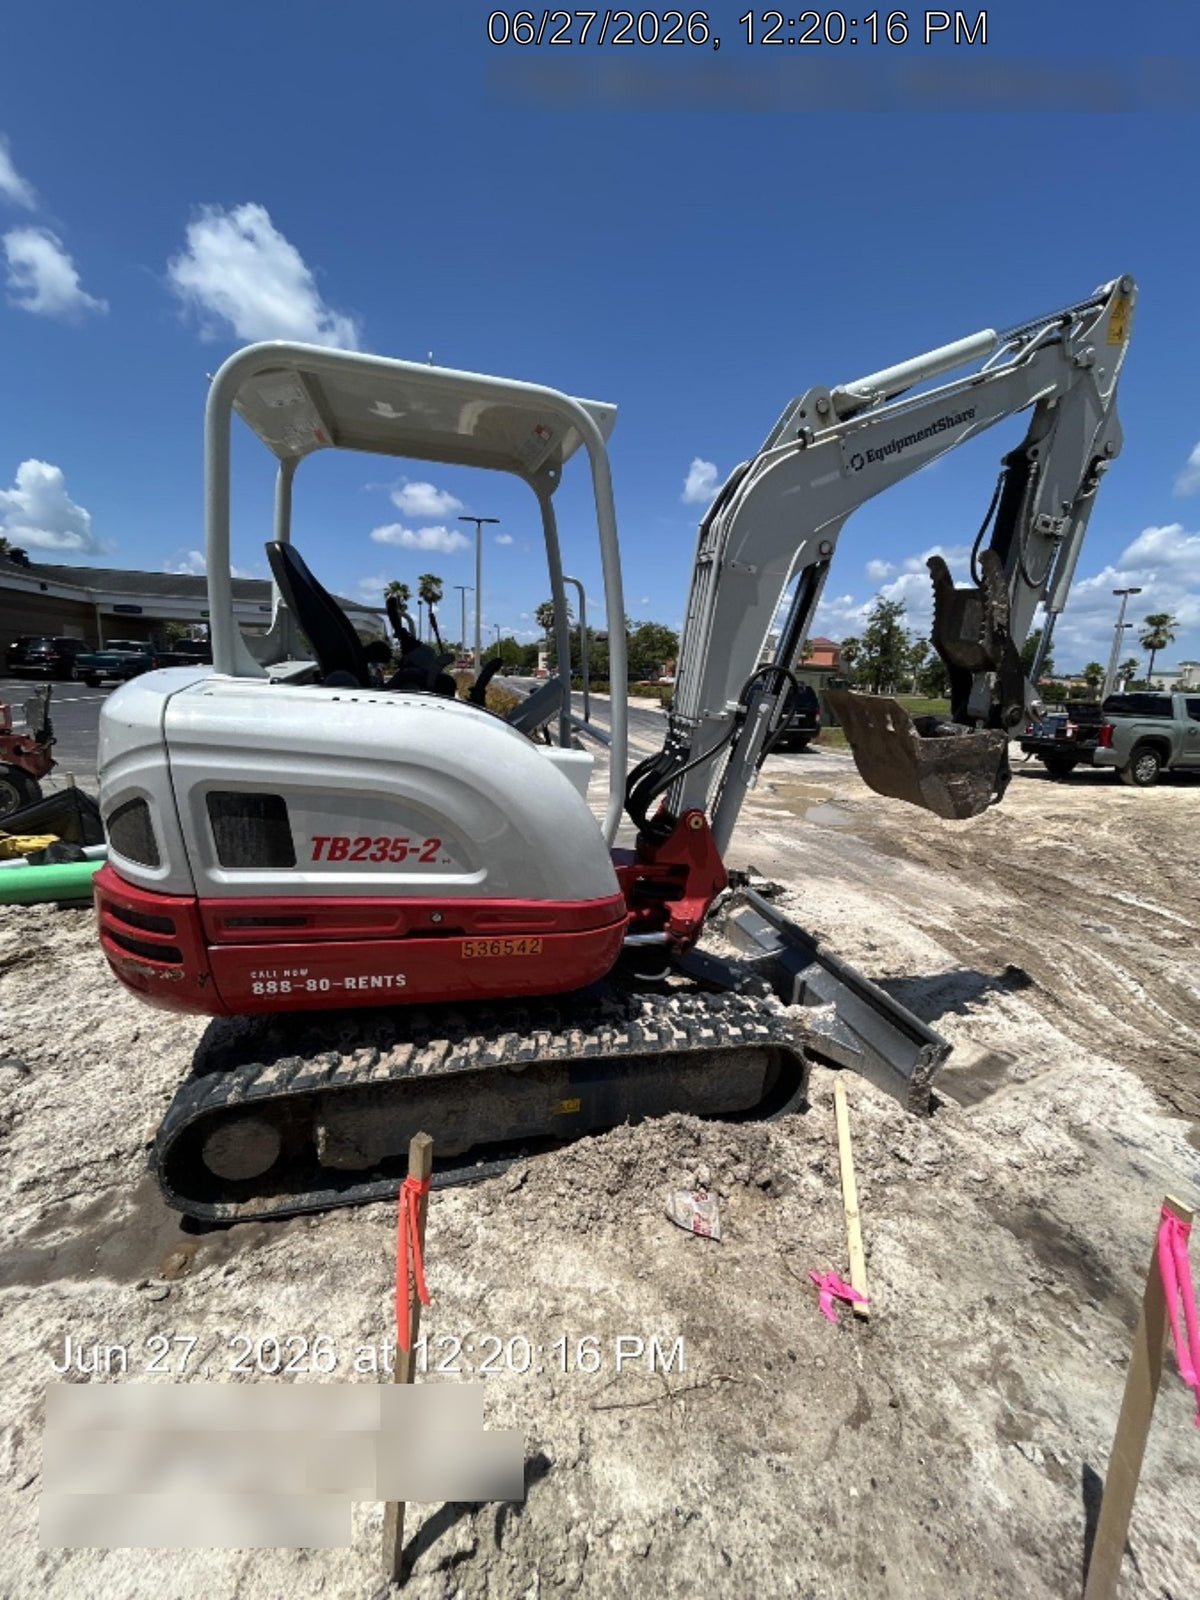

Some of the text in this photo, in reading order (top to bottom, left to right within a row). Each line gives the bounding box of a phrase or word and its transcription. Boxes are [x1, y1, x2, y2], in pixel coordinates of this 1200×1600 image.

[865, 408, 976, 463] EquipmentShare
[311, 836, 442, 863] TB235-2
[463, 938, 539, 957] 536542
[283, 968, 309, 977] NOW
[252, 974, 407, 995] 888-80-RENTS
